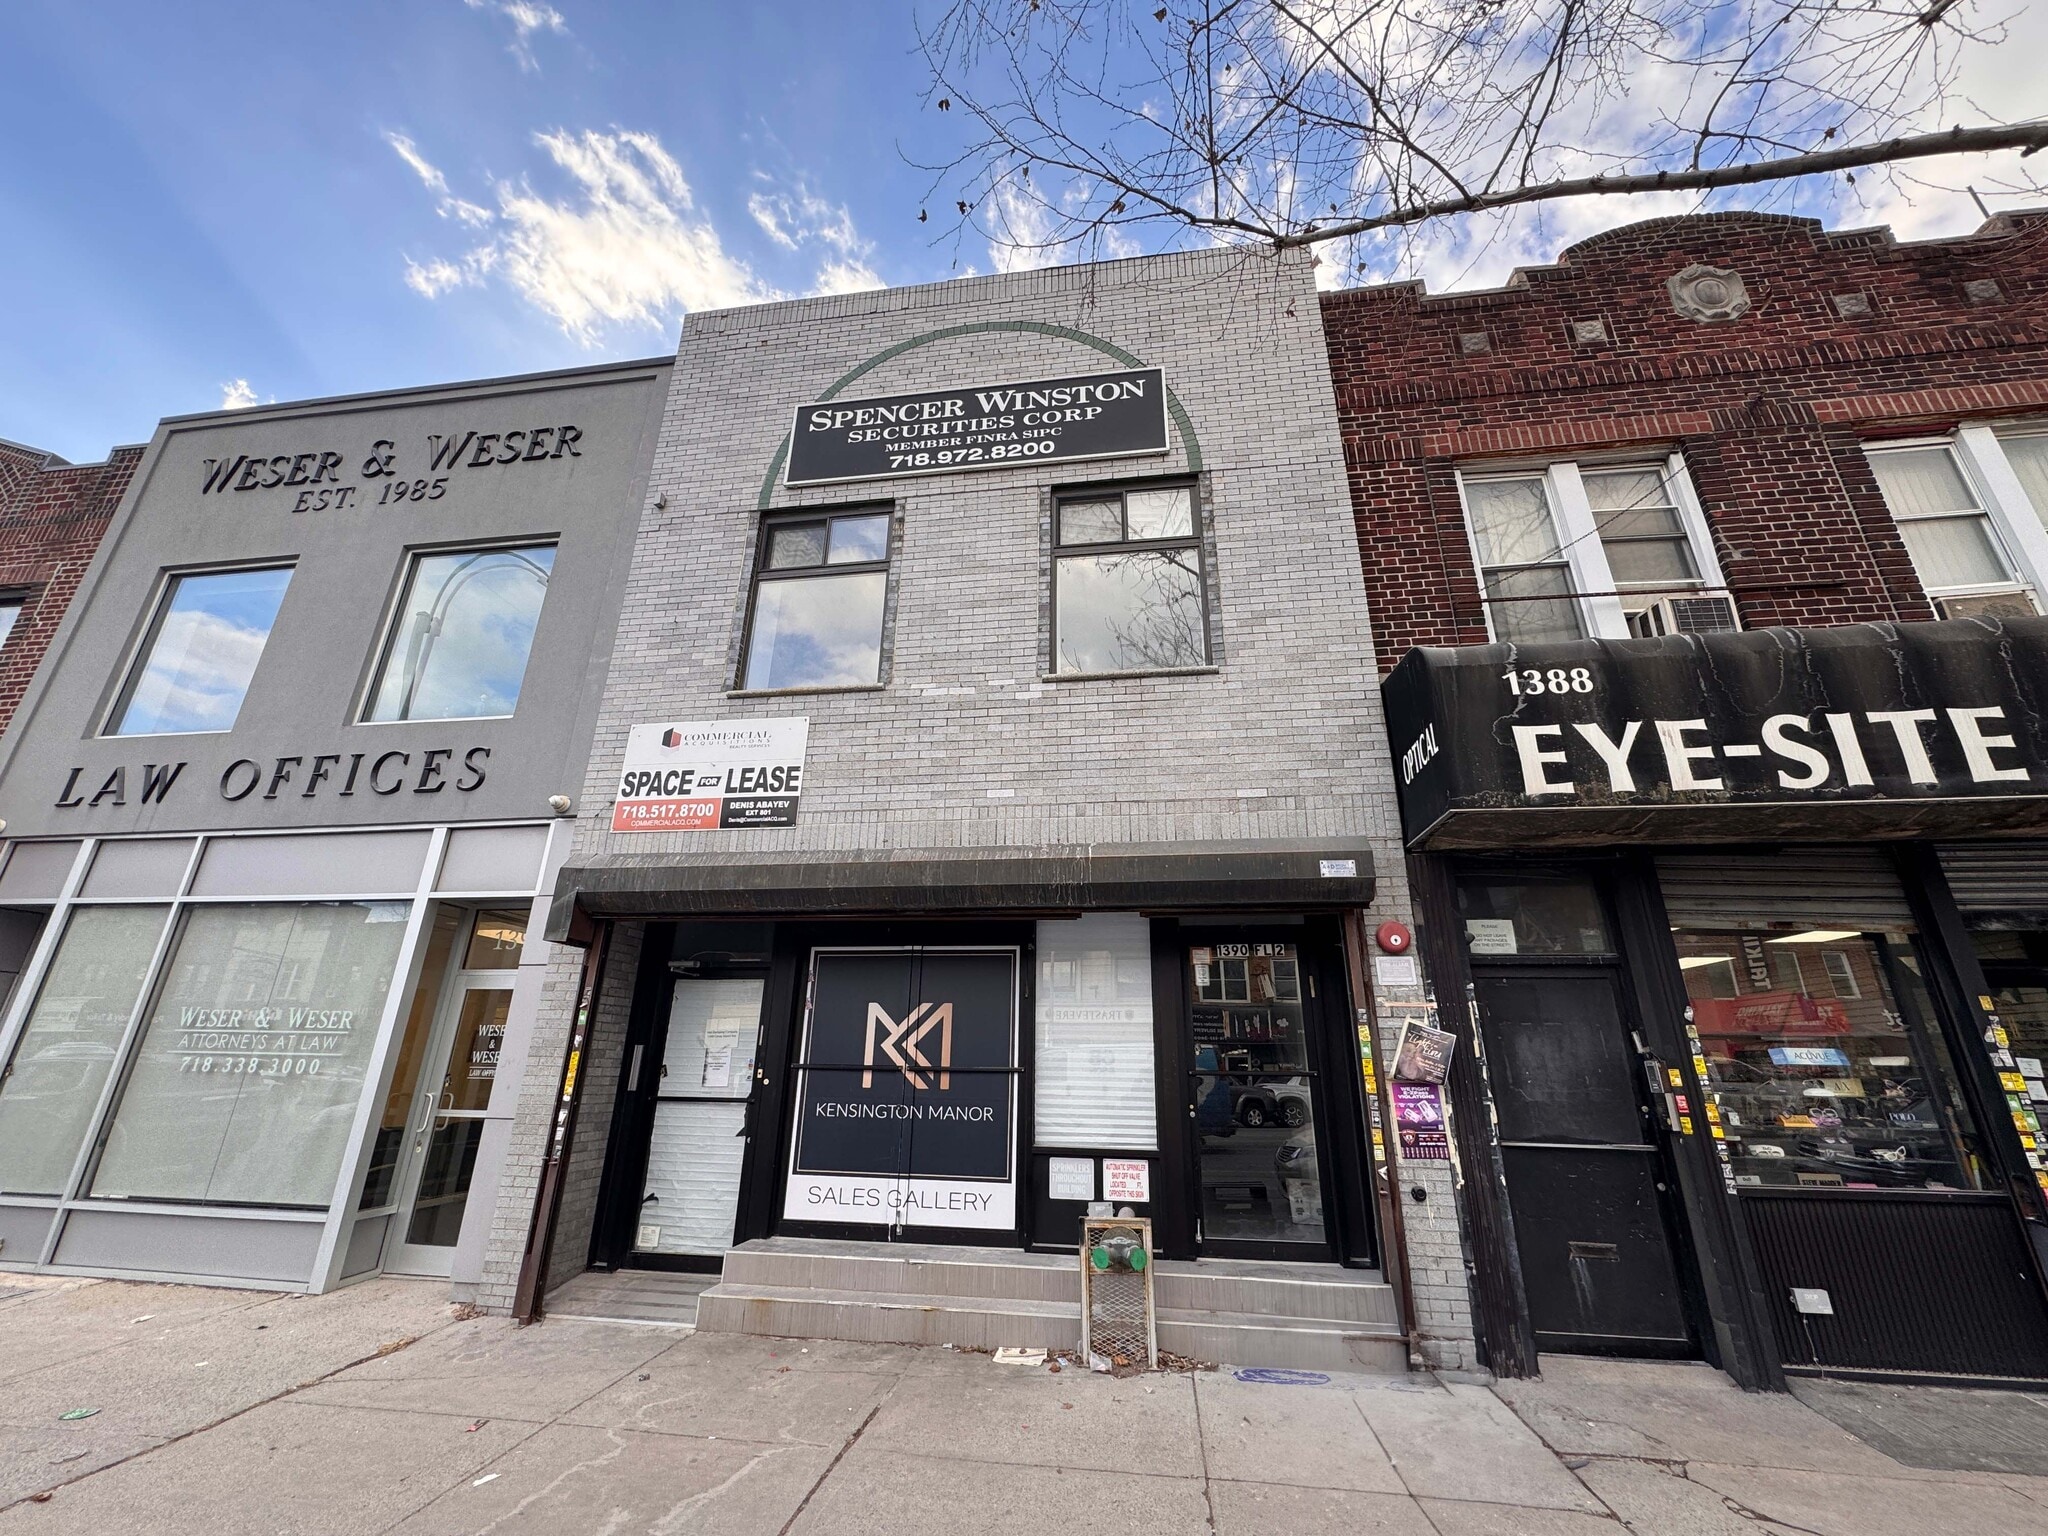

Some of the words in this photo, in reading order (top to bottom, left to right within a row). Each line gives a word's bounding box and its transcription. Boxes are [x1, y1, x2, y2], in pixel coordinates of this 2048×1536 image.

[809, 400, 965, 432] SPENCER
[975, 379, 1146, 414] WINSTON
[848, 415, 1015, 443] SECURITIES
[1023, 406, 1103, 425] CORP
[885, 435, 962, 452] MEMBER
[965, 431, 1018, 445] FINRA
[1022, 427, 1062, 440] SIPC
[202, 451, 343, 494] WESER
[361, 440, 395, 479] &
[428, 426, 584, 472] WESER
[889, 440, 1055, 469] 718.972.8200
[292, 488, 355, 513] EST.
[378, 478, 449, 505] 1985
[1501, 667, 1594, 696] 1388
[1402, 722, 1439, 786] OPTICAL
[1511, 706, 2031, 796] EYE-SITE
[55, 762, 187, 808] LAW
[220, 747, 492, 800] OFFICES
[621, 769, 695, 797] SPACE
[699, 778, 718, 786] FOR
[724, 766, 801, 794] LEASE
[622, 803, 714, 818] 718.517.8700
[1217, 945, 1248, 956] 1390
[1254, 944, 1272, 956] FL
[1275, 944, 1284, 956] 2
[179, 1006, 242, 1028] WESER
[254, 1006, 270, 1029] &
[288, 1006, 353, 1029] WESER
[177, 1033, 268, 1050] ATTORNEYS
[273, 1035, 296, 1050] AT
[301, 1035, 338, 1051] LAW
[488, 1039, 495, 1049] &
[179, 1056, 320, 1075] 718.338.3000
[1795, 1050, 1831, 1060] ACUVUE
[816, 1103, 923, 1120] KENSINGTON
[928, 1105, 994, 1122] MANOR
[1052, 1163, 1090, 1173] SPRINKLERS
[1052, 1173, 1092, 1184] THROUGHOUT
[1111, 1172, 1121, 1180] SHUT
[1121, 1172, 1129, 1180] OFF
[807, 1185, 880, 1208] SALES
[886, 1187, 993, 1212] GALLERY
[1057, 1184, 1086, 1194] BUILDING
[1108, 1190, 1126, 1198] OPPOSITE
[1135, 1190, 1144, 1198] SIGN
